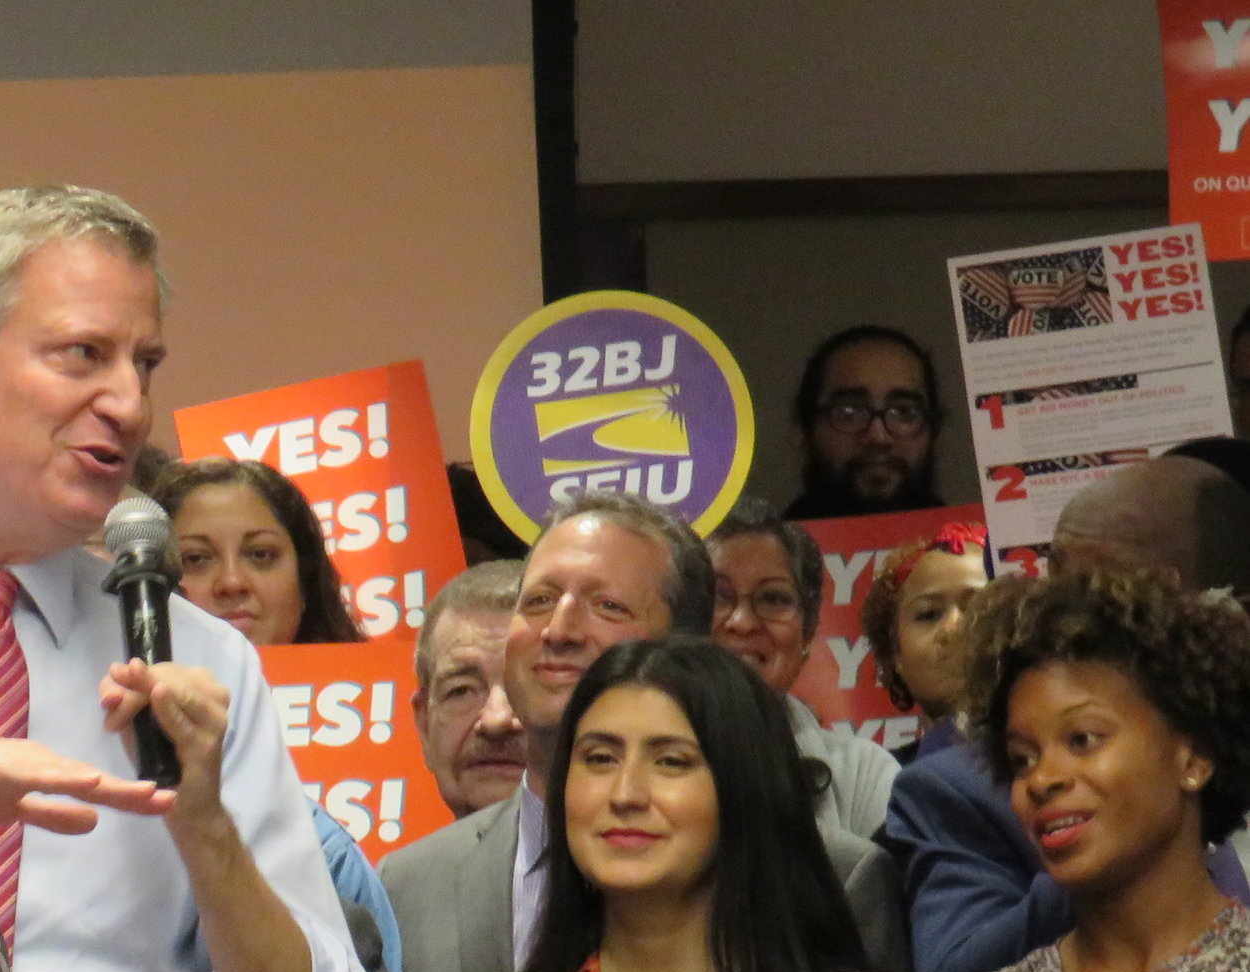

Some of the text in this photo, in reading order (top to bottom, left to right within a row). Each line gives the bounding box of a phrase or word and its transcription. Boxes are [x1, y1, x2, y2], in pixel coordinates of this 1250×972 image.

[1194, 177, 1222, 193] ON
[1109, 234, 1195, 265] YES!
[1113, 261, 1200, 293] YES!
[1117, 289, 1205, 322] YES!
[526, 334, 678, 398] 32BJ
[980, 394, 1005, 430] 1
[991, 465, 1028, 502] 2
[270, 680, 396, 748] ES!
